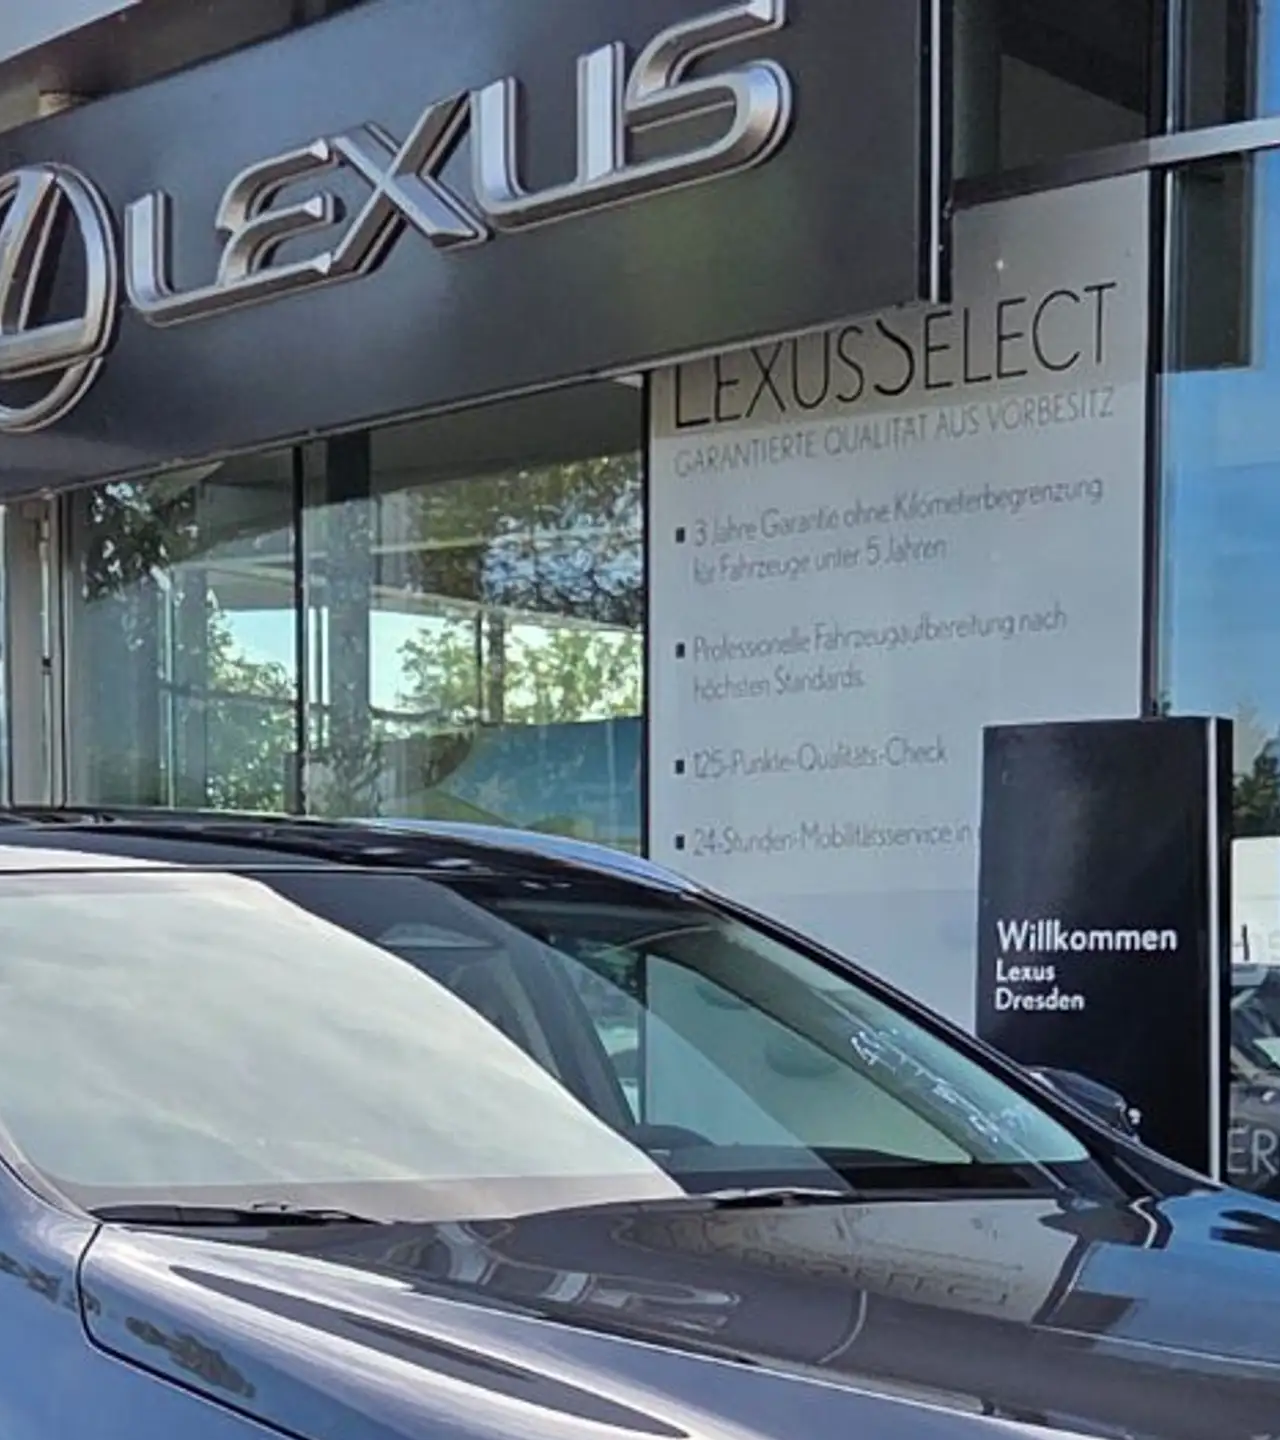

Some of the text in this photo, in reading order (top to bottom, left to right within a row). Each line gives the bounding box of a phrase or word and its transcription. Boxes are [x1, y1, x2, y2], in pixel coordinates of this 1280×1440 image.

[124, 0, 794, 328] LEXUS
[673, 428, 817, 478] GARANTIERTE
[933, 405, 981, 440] AUS
[986, 385, 1117, 434] VORBESITZ
[693, 518, 708, 547] 3
[843, 498, 891, 528] ohne
[867, 534, 881, 566] 5
[1019, 600, 1067, 632] nach
[996, 918, 1179, 952] Willkommen
[995, 958, 1056, 982] Lexus
[994, 985, 1085, 1012] Dresden
